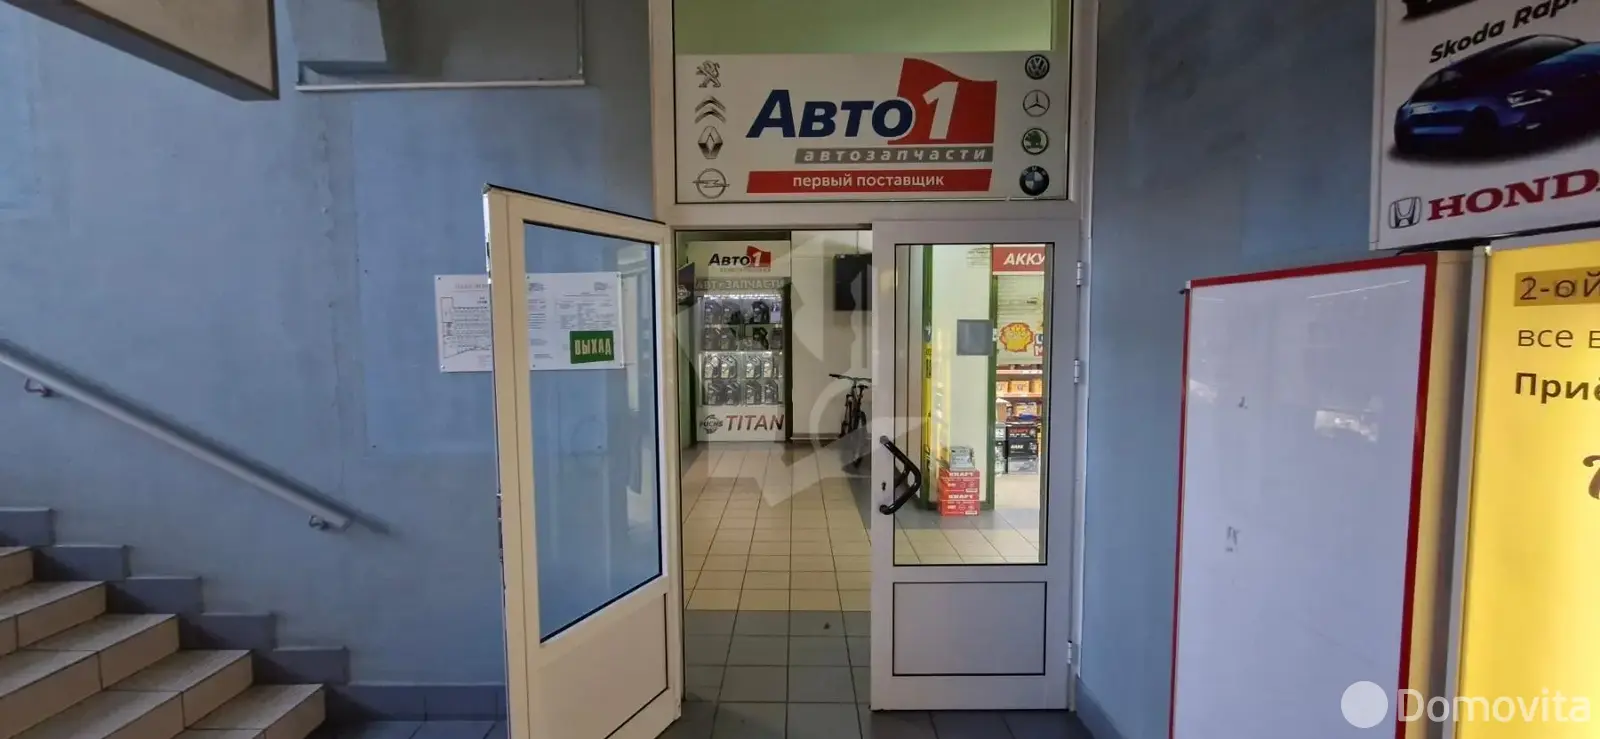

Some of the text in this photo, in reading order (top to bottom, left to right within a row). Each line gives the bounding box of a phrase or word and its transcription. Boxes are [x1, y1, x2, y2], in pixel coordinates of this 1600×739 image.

[1429, 0, 1578, 63] Skoda Rap
[803, 148, 987, 163] автозапчасти
[793, 171, 945, 188] первый поставщик
[1427, 169, 1600, 221] HOND
[1517, 329, 1574, 349] все
[726, 414, 785, 431] TITAN
